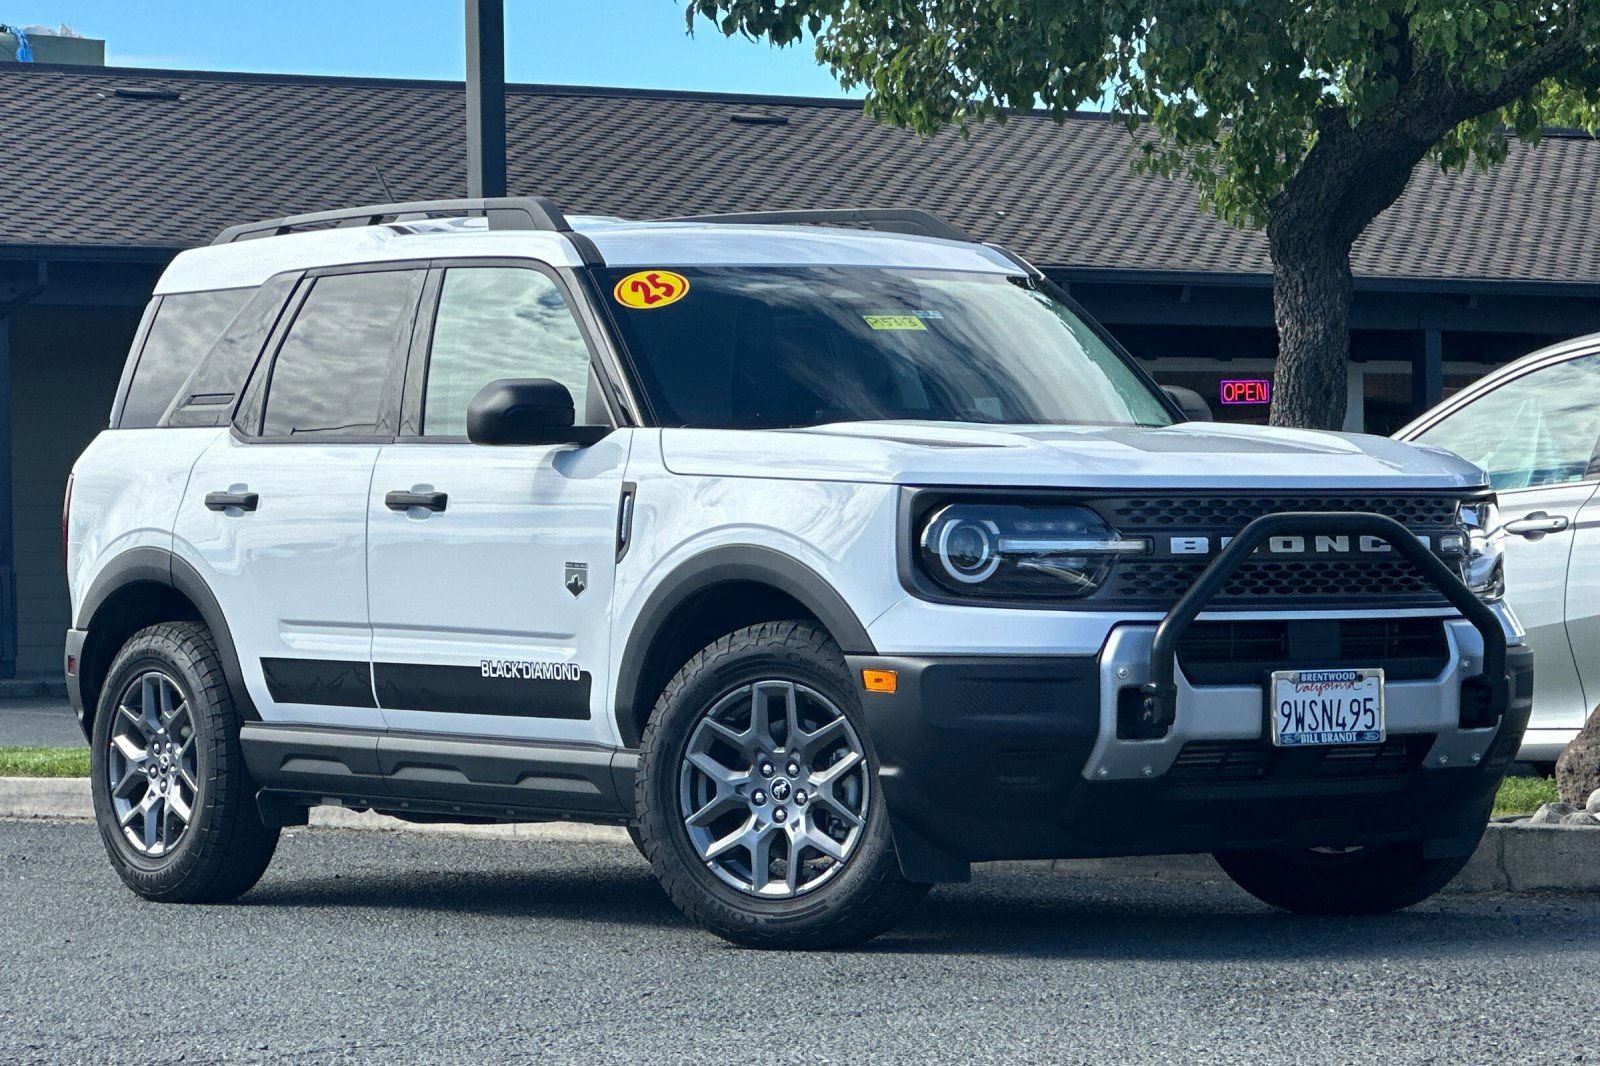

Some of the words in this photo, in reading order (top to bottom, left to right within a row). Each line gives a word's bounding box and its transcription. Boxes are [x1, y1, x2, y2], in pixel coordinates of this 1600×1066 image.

[630, 273, 674, 304] 25
[1223, 383, 1267, 401] OPEN
[1170, 536, 1430, 553] BONC
[480, 660, 520, 678] BLACK
[522, 662, 580, 681] DIAMOND
[1301, 672, 1356, 682] BRENTWOOD
[1281, 698, 1376, 733] 9WSN495
[1301, 733, 1320, 744] BILL
[1321, 732, 1357, 743] BRANDT
